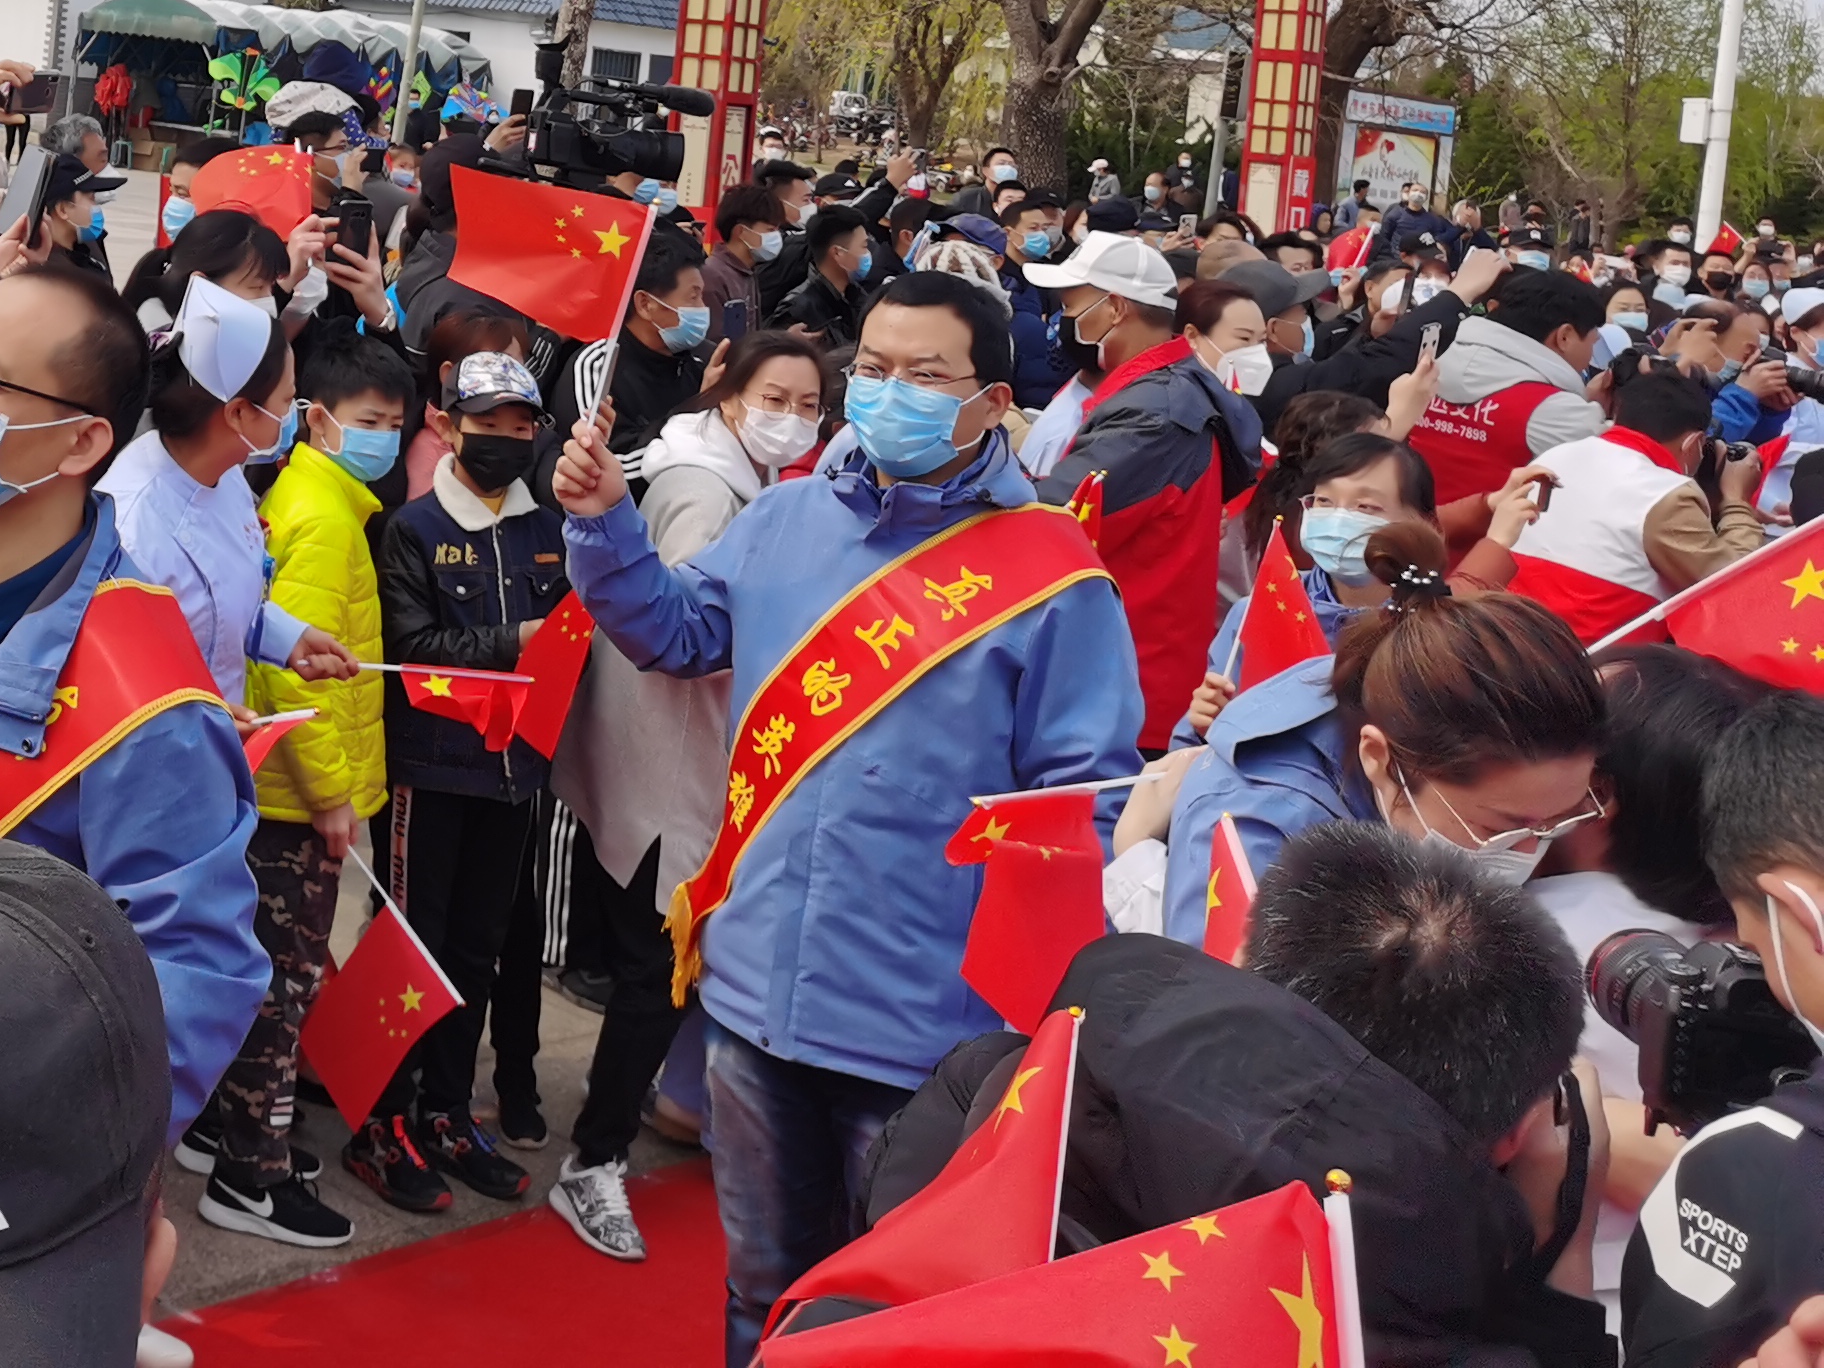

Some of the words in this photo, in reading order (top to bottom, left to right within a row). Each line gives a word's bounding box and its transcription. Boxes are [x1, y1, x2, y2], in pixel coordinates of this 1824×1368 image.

[1415, 416, 1487, 442] 00-998-7898
[1679, 1198, 1749, 1252] SPORTS
[1683, 1225, 1742, 1273] XTEP
